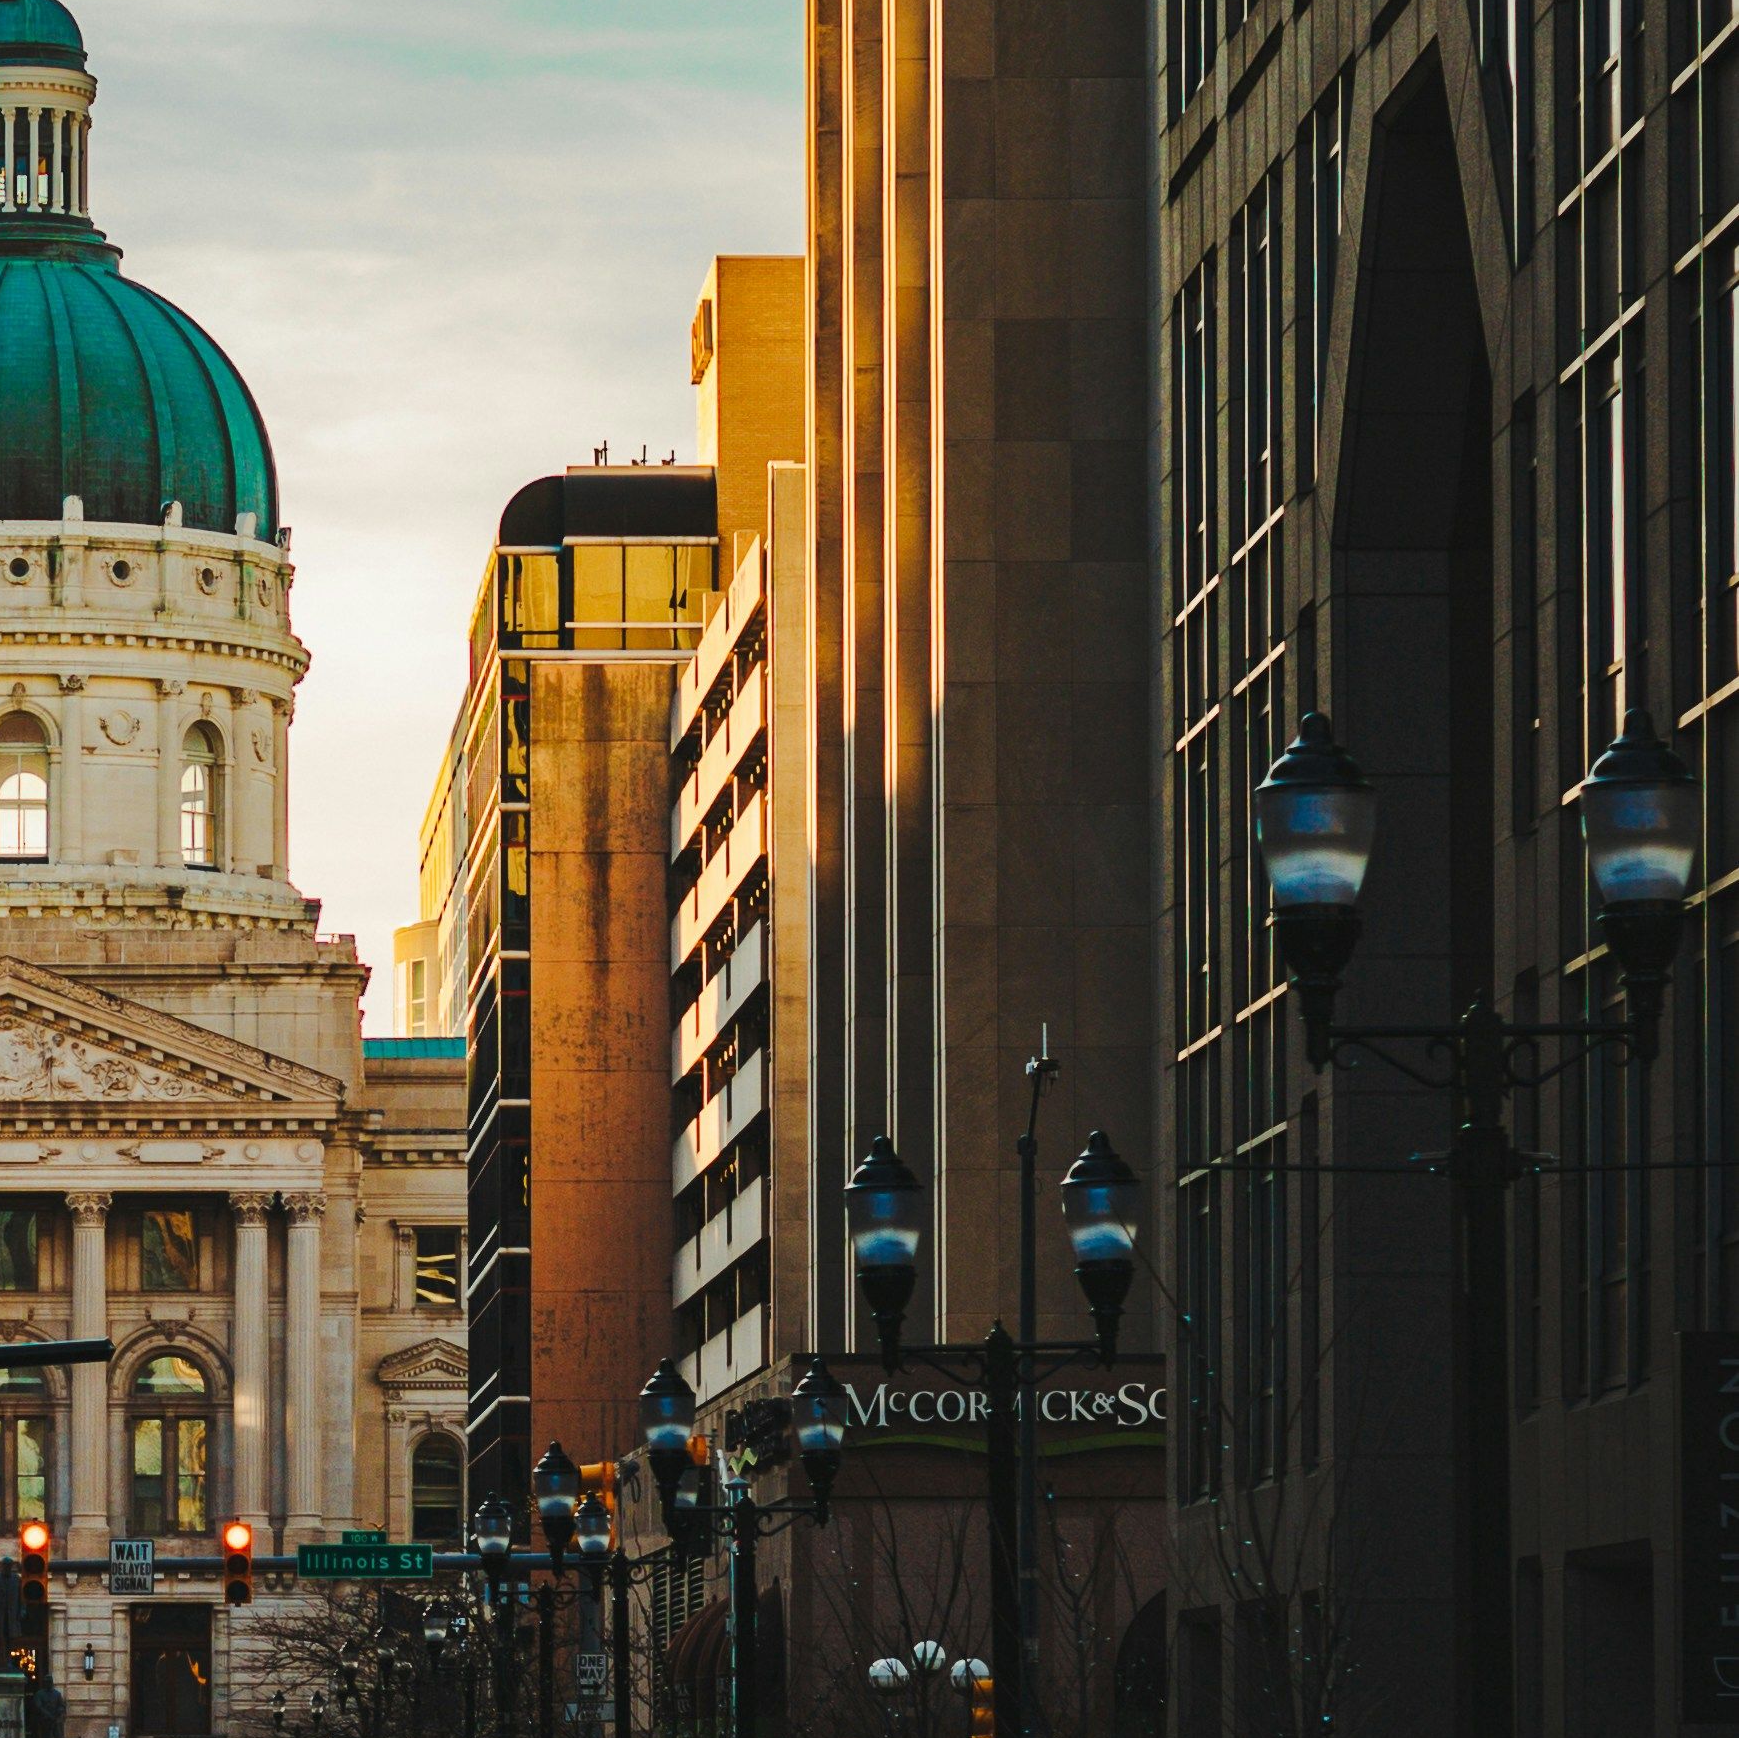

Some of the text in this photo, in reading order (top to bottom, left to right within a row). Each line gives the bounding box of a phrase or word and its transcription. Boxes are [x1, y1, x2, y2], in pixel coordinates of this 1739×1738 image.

[350, 1534, 368, 1543] 100
[115, 1543, 149, 1561] WAIT
[307, 1553, 423, 1569] Illinois St
[111, 1562, 151, 1576] DELAYED
[114, 1577, 149, 1591] SIGNAL
[579, 1655, 604, 1667] ONE
[579, 1668, 605, 1679] WAY
